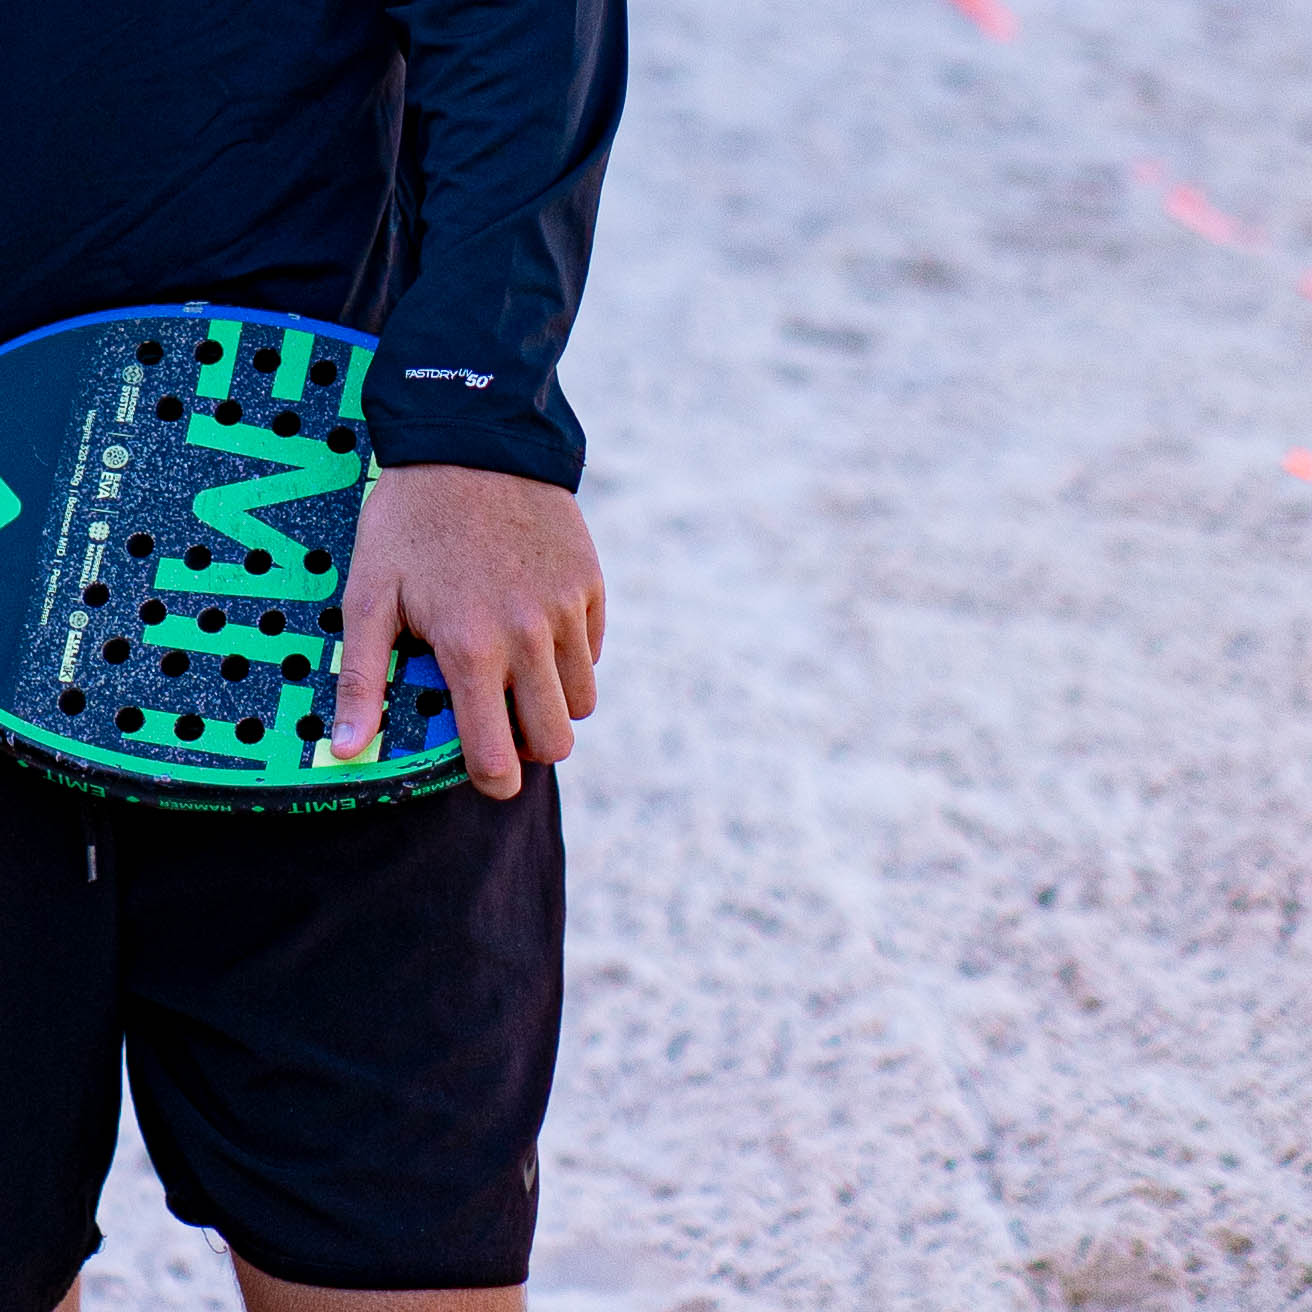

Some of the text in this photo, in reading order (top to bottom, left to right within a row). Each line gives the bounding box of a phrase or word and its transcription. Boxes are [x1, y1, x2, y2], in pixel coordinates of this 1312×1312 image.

[405, 368, 458, 380] FASTDRY
[116, 385, 132, 423] SYSTEM
[96, 471, 114, 499] EVA
[43, 769, 106, 799] EMIT
[411, 772, 468, 797] AMMER
[159, 800, 233, 813] HAMMER
[288, 798, 357, 815] EMIT
